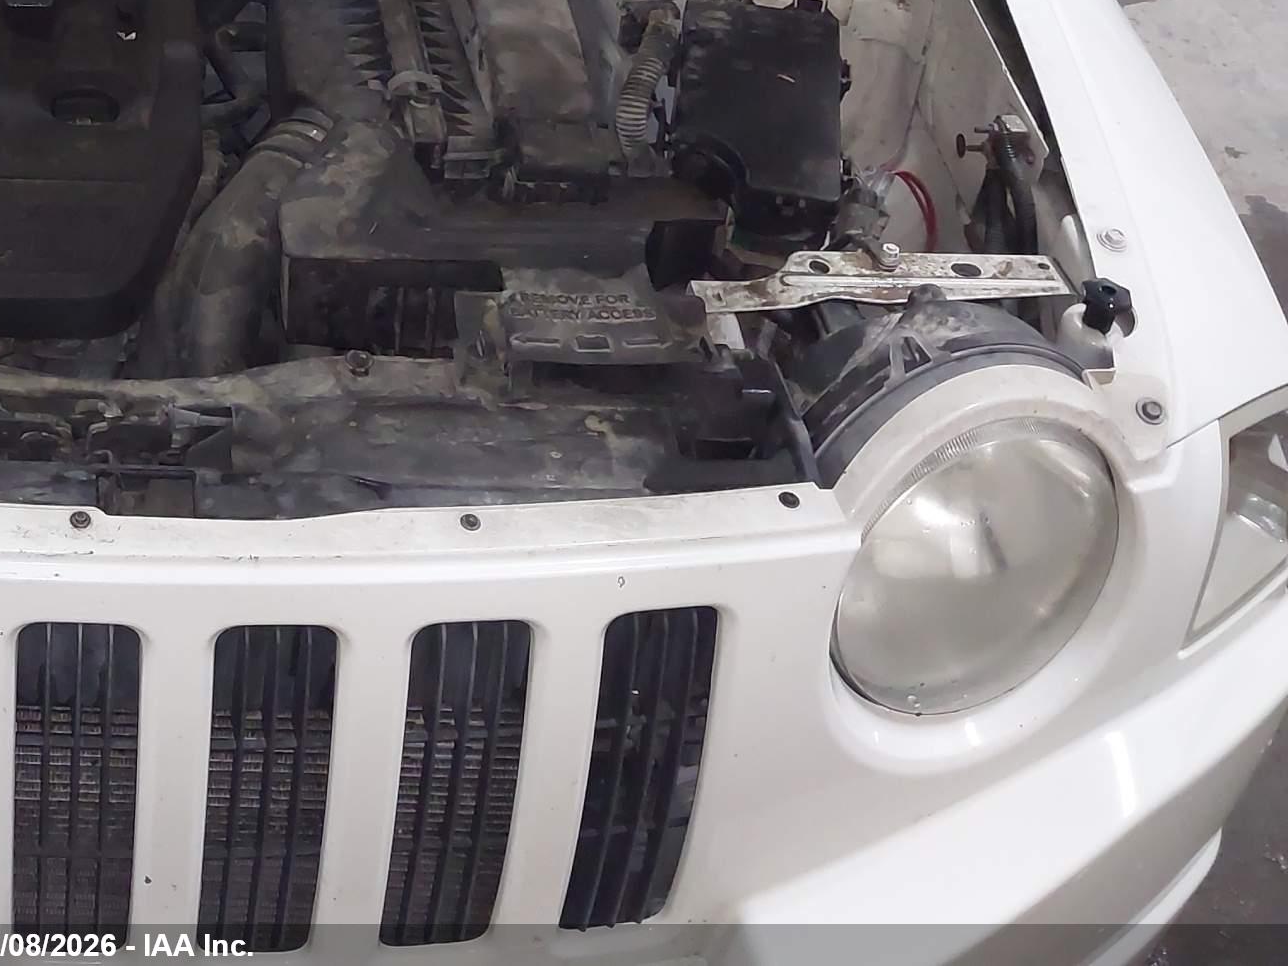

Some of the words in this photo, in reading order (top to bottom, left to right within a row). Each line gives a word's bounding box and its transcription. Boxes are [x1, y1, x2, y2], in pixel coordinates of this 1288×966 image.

[519, 292, 591, 306] REMOVE
[596, 293, 631, 305] FOR
[588, 307, 656, 321] ACCESS
